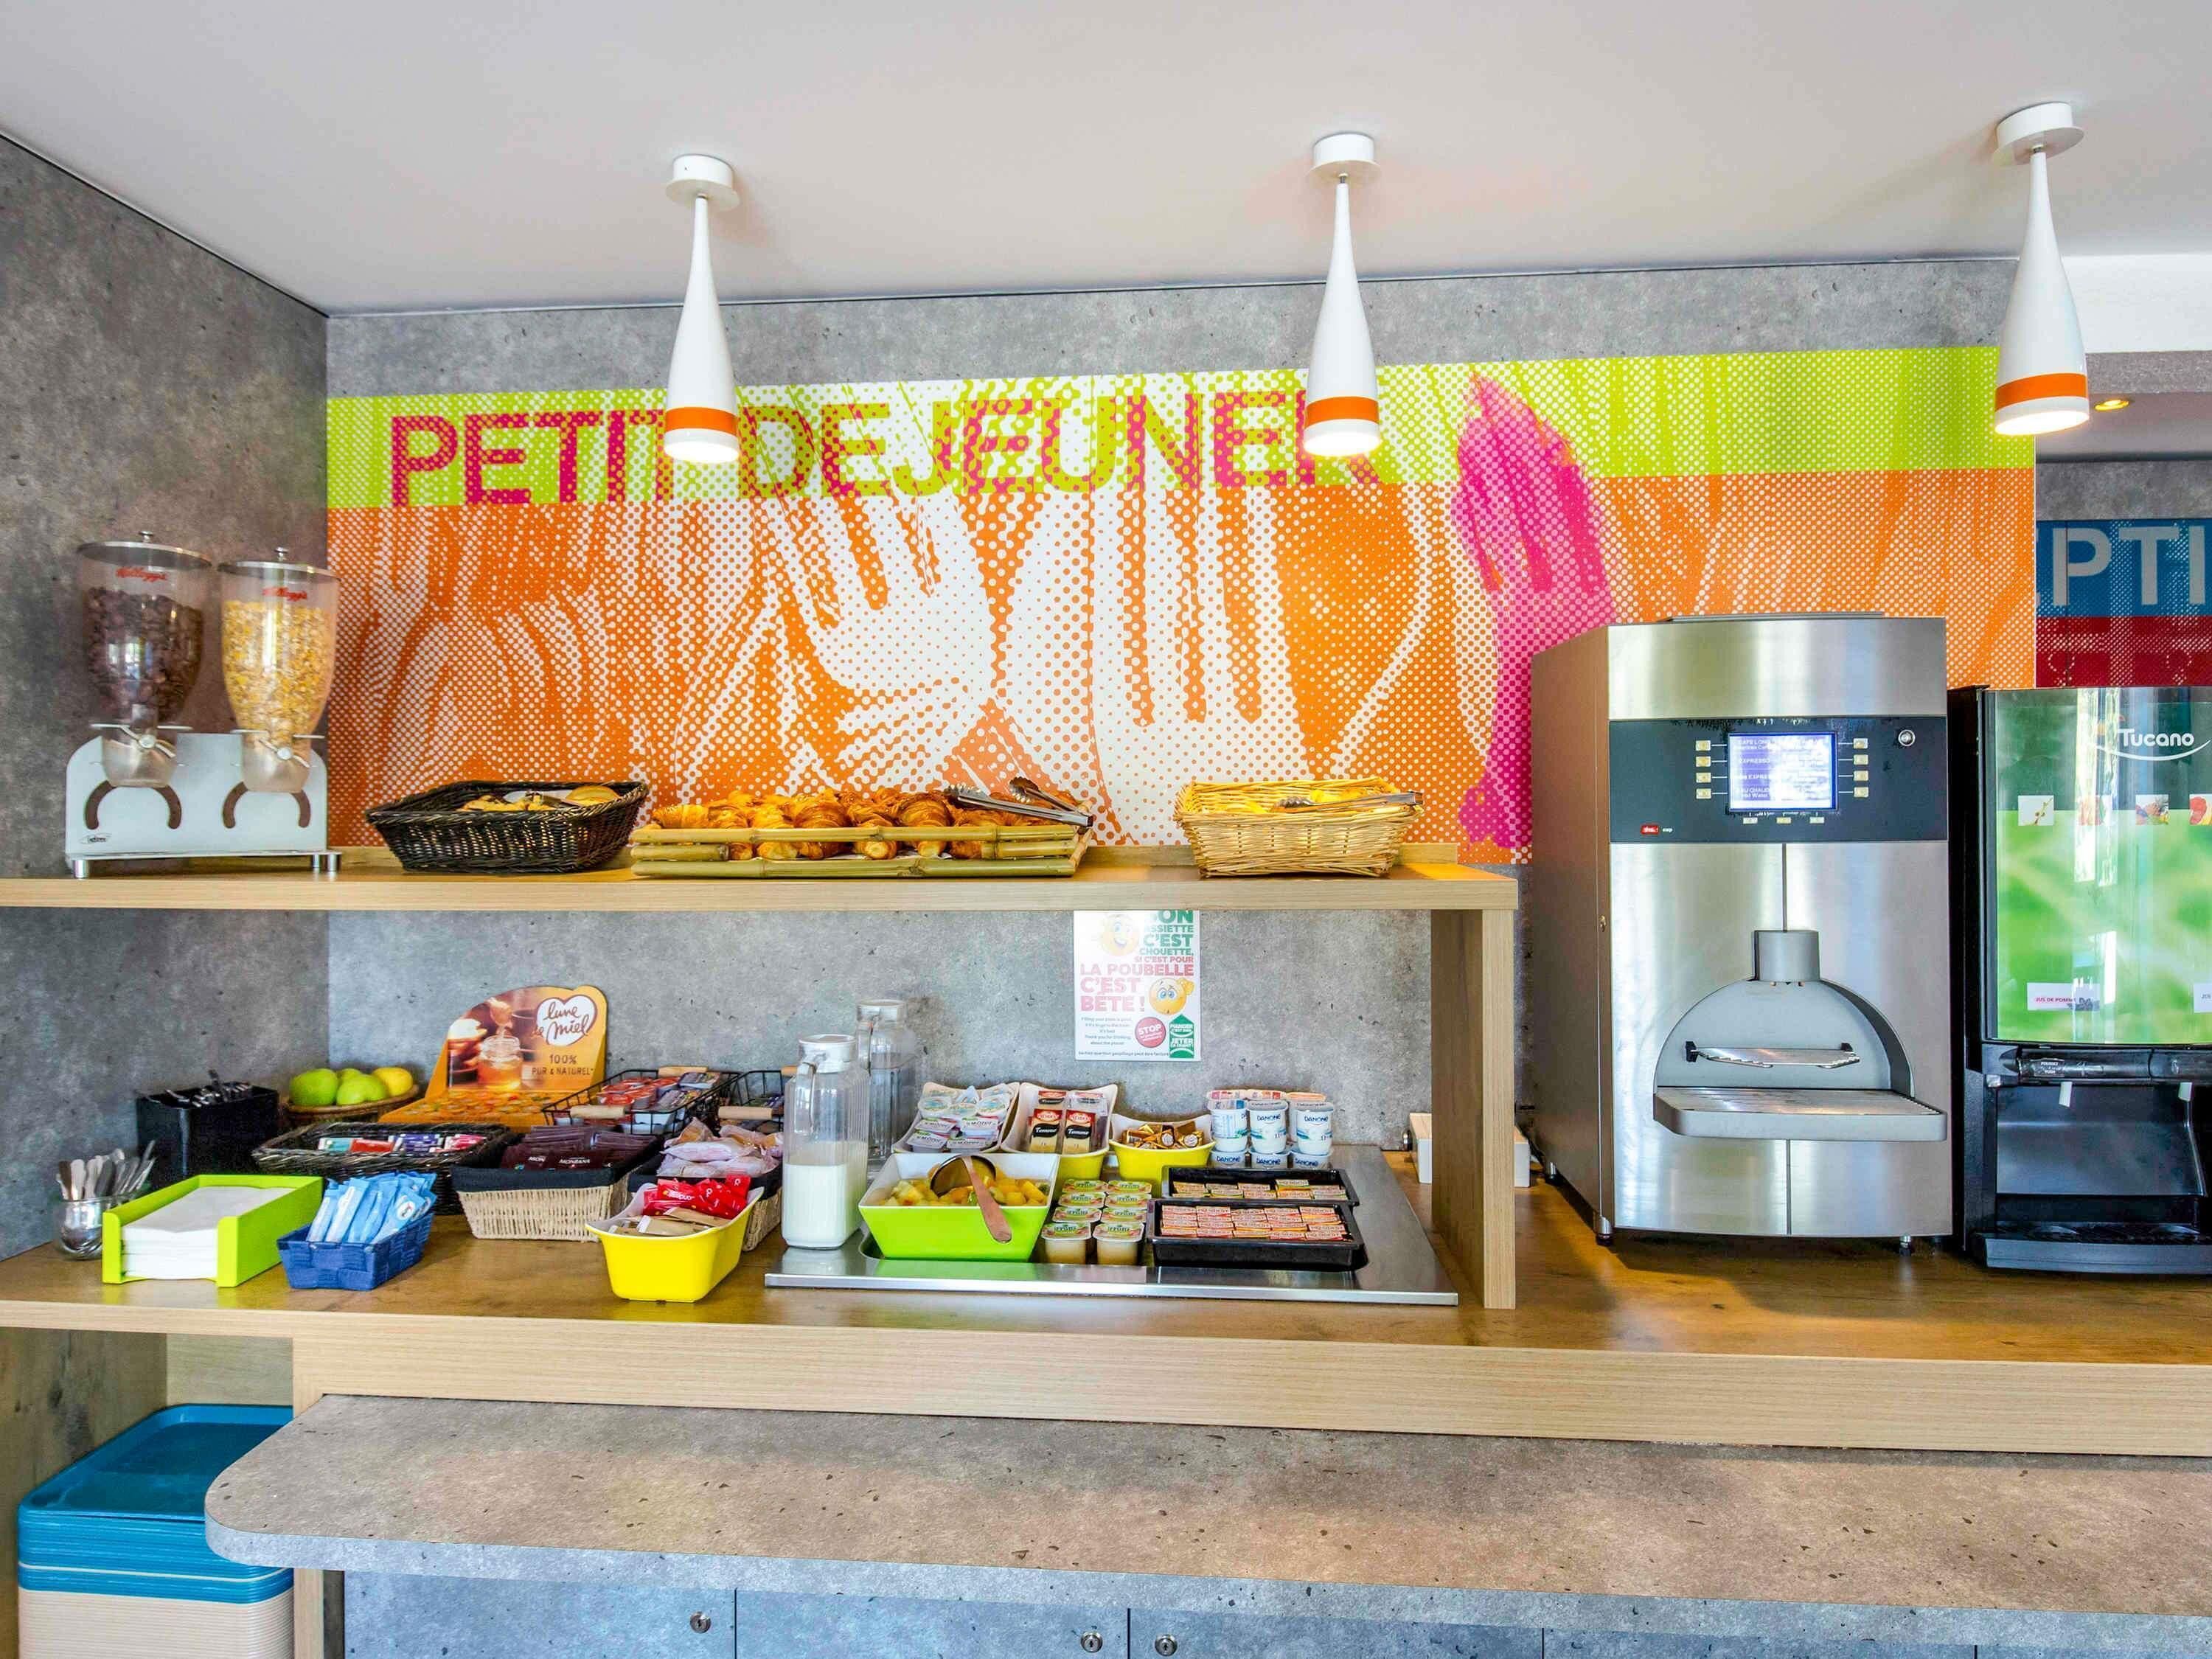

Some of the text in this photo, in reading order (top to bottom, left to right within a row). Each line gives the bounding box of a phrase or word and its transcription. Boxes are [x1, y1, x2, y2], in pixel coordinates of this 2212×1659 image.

[2036, 525, 2205, 607] PTI
[2118, 728, 2194, 746] Tucano
[1145, 925, 1194, 933] SSIETTE
[1144, 933, 1193, 947] C'EST
[1080, 964, 1194, 976] LA POUBELLE
[1080, 977, 1141, 992] C'EST
[1138, 1023, 1163, 1035] STOP
[549, 1054, 578, 1065] 100%
[532, 1067, 547, 1076] PUR
